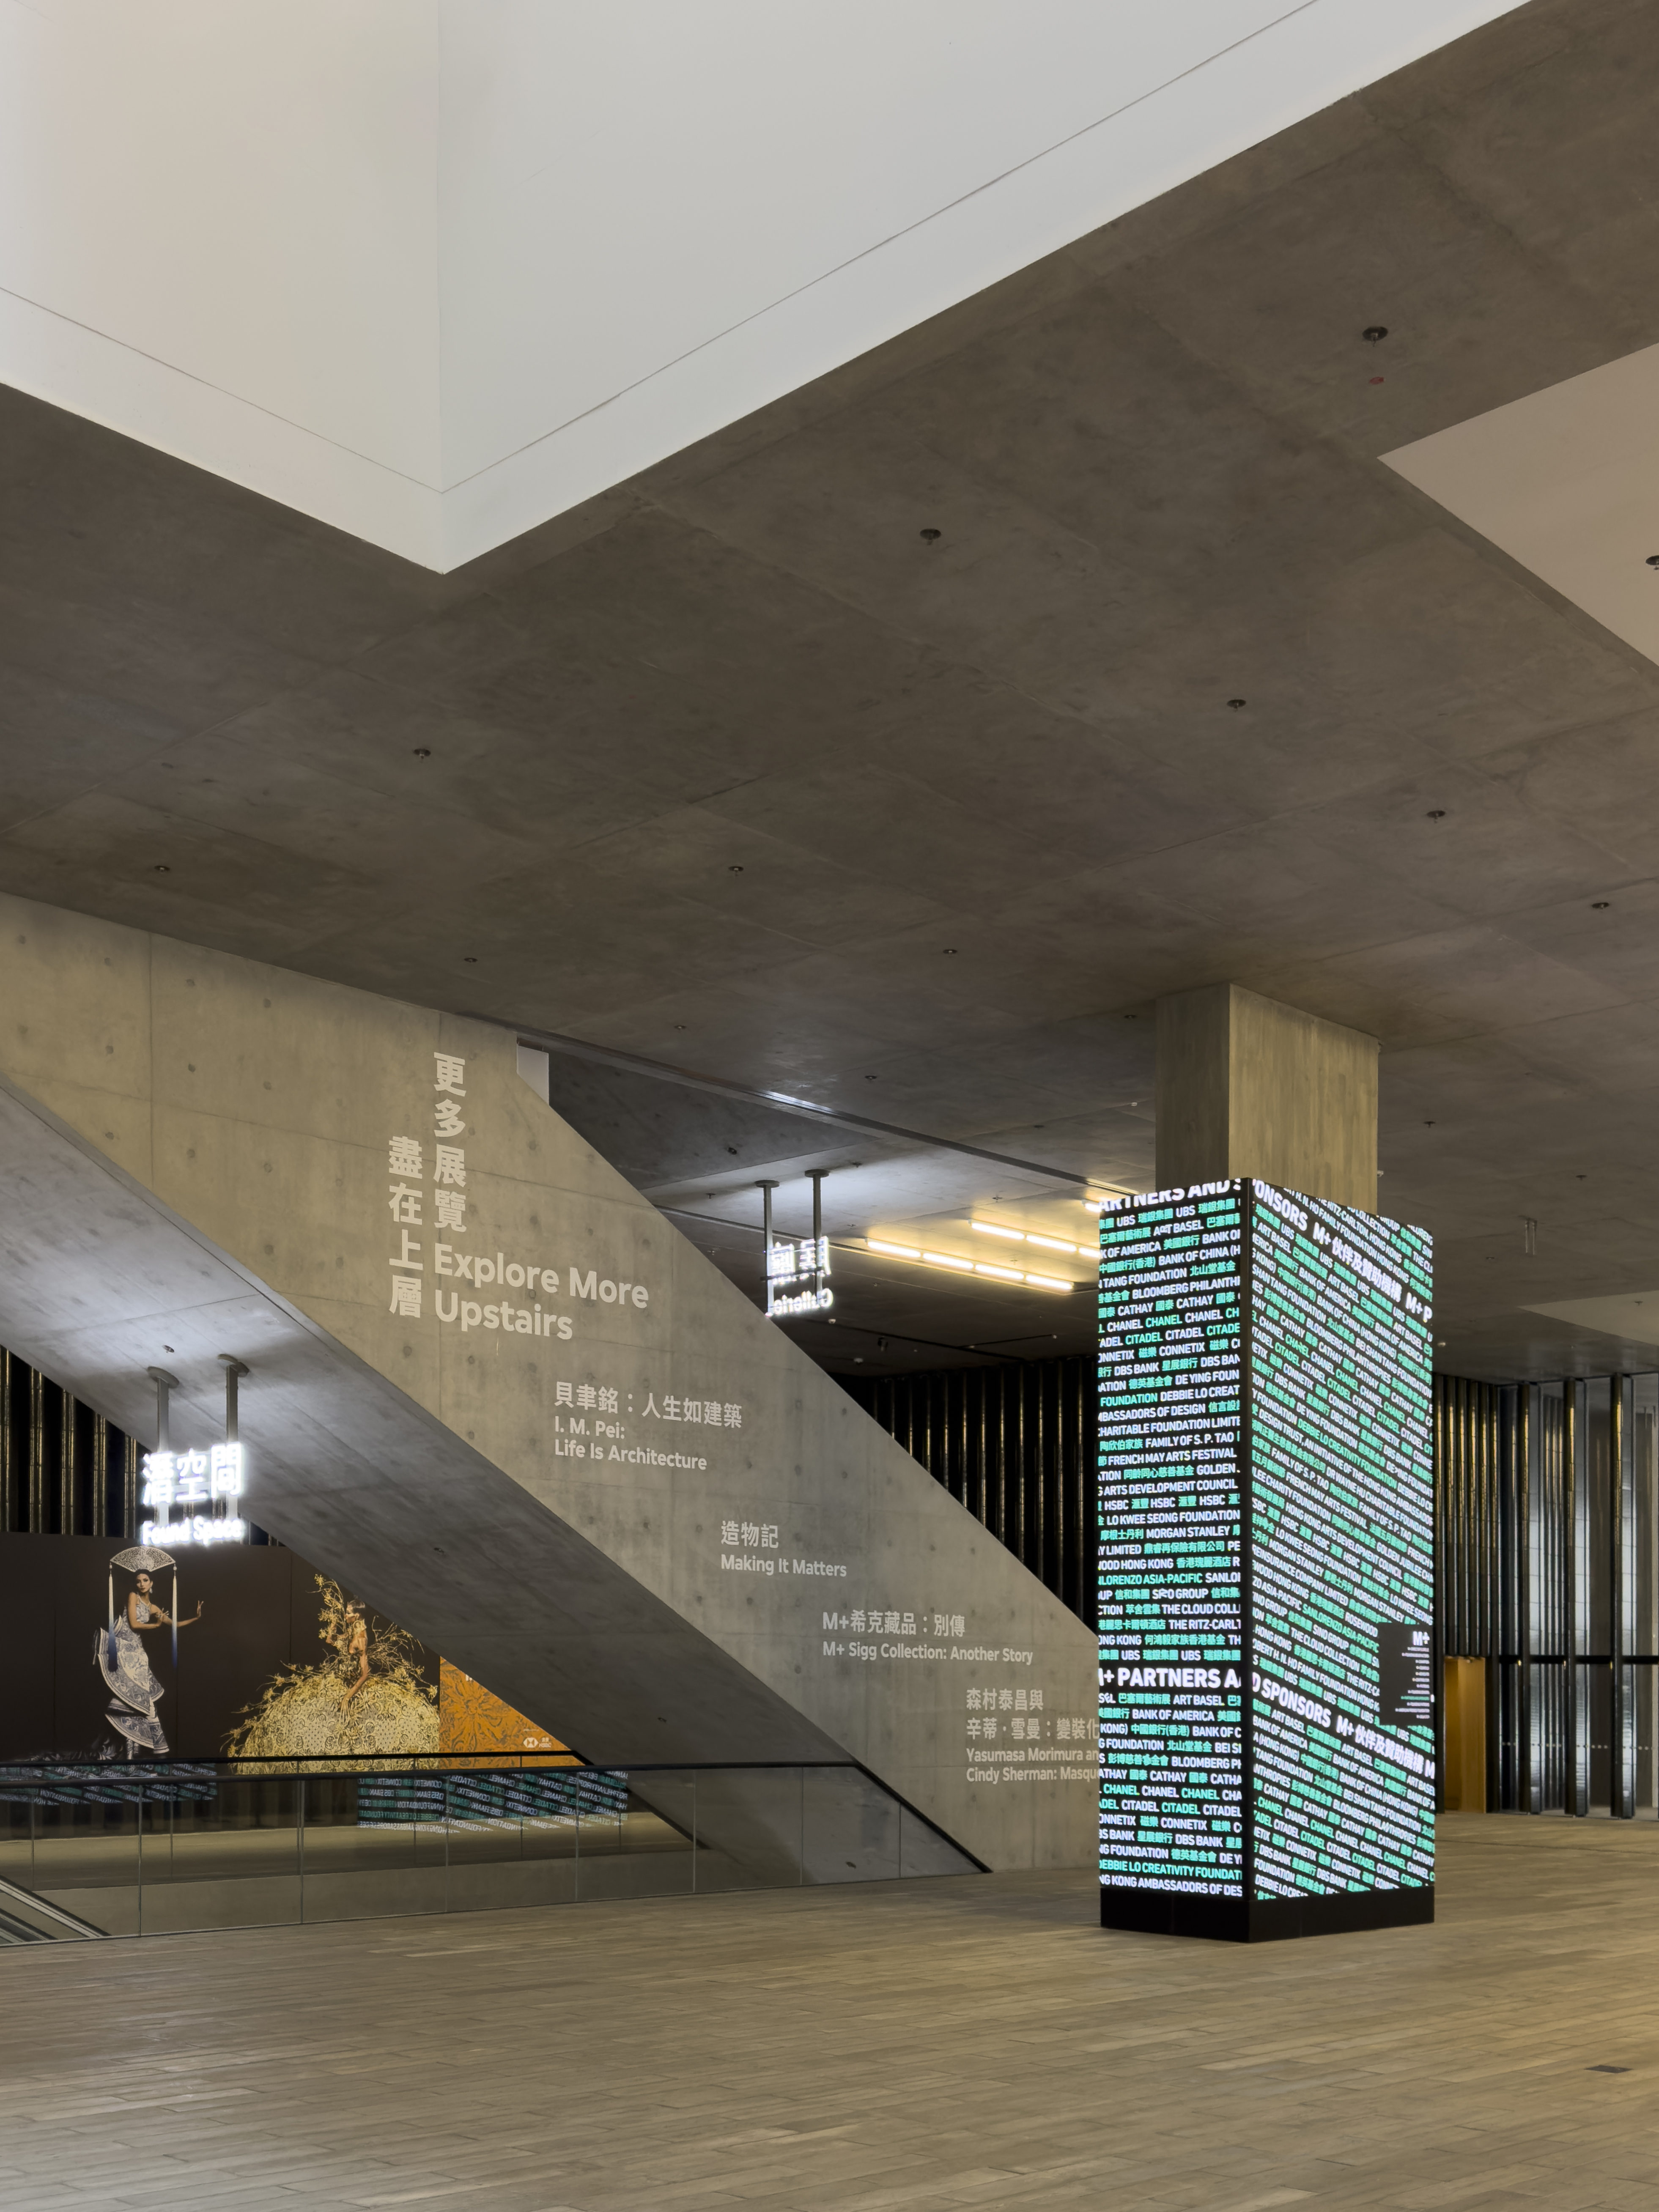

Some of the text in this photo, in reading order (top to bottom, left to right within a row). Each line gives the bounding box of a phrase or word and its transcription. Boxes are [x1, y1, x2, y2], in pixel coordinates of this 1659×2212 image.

[433, 1052, 466, 1232] 更多展覽
[1116, 1214, 1135, 1227] UBS
[1176, 1205, 1196, 1217] UBS
[389, 1136, 423, 1318] 盡在上層
[1173, 1219, 1204, 1233] BASEL
[1107, 1247, 1120, 1258] OF
[1120, 1241, 1161, 1255] AMERICA
[1202, 1231, 1229, 1244] BANK
[1158, 1253, 1185, 1265] BANK
[1185, 1250, 1198, 1262] OF
[1199, 1246, 1229, 1260] CHINA
[435, 1243, 648, 1308] Explore More
[1313, 1222, 1331, 1244] M+
[1405, 1292, 1423, 1313] M+
[1102, 1276, 1127, 1288] TANG
[1128, 1267, 1187, 1285] FOUNDATION
[1132, 1283, 1189, 1299] BLOOMBERG
[436, 1288, 573, 1339] Upstairs
[1117, 1302, 1153, 1316] CATHAY
[1176, 1295, 1213, 1308] CATHAY
[1107, 1314, 1182, 1332] CHANEL CHANEL
[1125, 1327, 1204, 1344] CITADEL CITADEL
[1159, 1342, 1205, 1356] CONNETIX
[1114, 1365, 1133, 1376] DBS
[1133, 1362, 1159, 1373] BANK
[1200, 1356, 1220, 1367] DBS
[1175, 1374, 1188, 1384] DE
[1189, 1372, 1211, 1384] YING
[1099, 1387, 1208, 1406] FOUNDATION DEBBIE LO
[1157, 1403, 1205, 1417] OF DESIGN
[555, 1416, 624, 1439] I. M. Pei:
[1150, 1418, 1210, 1433] FOUNDATION
[1145, 1436, 1179, 1447] FAMILY
[1179, 1435, 1193, 1445] OF
[1214, 1432, 1234, 1443] TAO
[556, 1439, 707, 1470] Life Is Architecture
[1108, 1447, 1237, 1465] FRENCH MAY ARTS FESTIVAL
[1196, 1463, 1235, 1475] GOLDEN
[1104, 1478, 1238, 1495] ARTS DEVELOPMENT COUNCIL
[1104, 1494, 1225, 1510] HSBC HSBC HSBC
[1107, 1509, 1240, 1525] LO KWEE SEONG FOUNDATION
[142, 1516, 244, 1546] Found Space
[721, 1521, 778, 1548] 造物記
[1146, 1527, 1186, 1538] MORGAN
[1187, 1525, 1230, 1537] STANLEY
[1106, 1544, 1141, 1555] LIMITED
[721, 1554, 846, 1576] Making It Matters
[1121, 1559, 1146, 1570] HONG
[1147, 1558, 1174, 1569] KONG
[1143, 1573, 1202, 1584] ASIA-PACIFIC
[1175, 1588, 1208, 1598] GROUP
[1161, 1603, 1213, 1614] THE CLOUD
[1168, 1619, 1187, 1629] THE
[1116, 1635, 1141, 1645] KONG
[1413, 1631, 1430, 1646] M+
[823, 1642, 1033, 1665] M+ Sigg Collection: Another Story
[1117, 1668, 1221, 1687] PARTNERS
[1262, 1679, 1330, 1727] SPONSORS
[1336, 1715, 1354, 1735] M+
[967, 1748, 1025, 1762] Yasumasa
[1028, 1747, 1083, 1761] Morimura
[967, 1767, 1099, 1784] Cindy Sherman: Masqu
[1129, 1861, 1194, 1876] LO CREATIVITY
[1111, 1875, 1223, 1894] KONG AMBASSADORS OF
